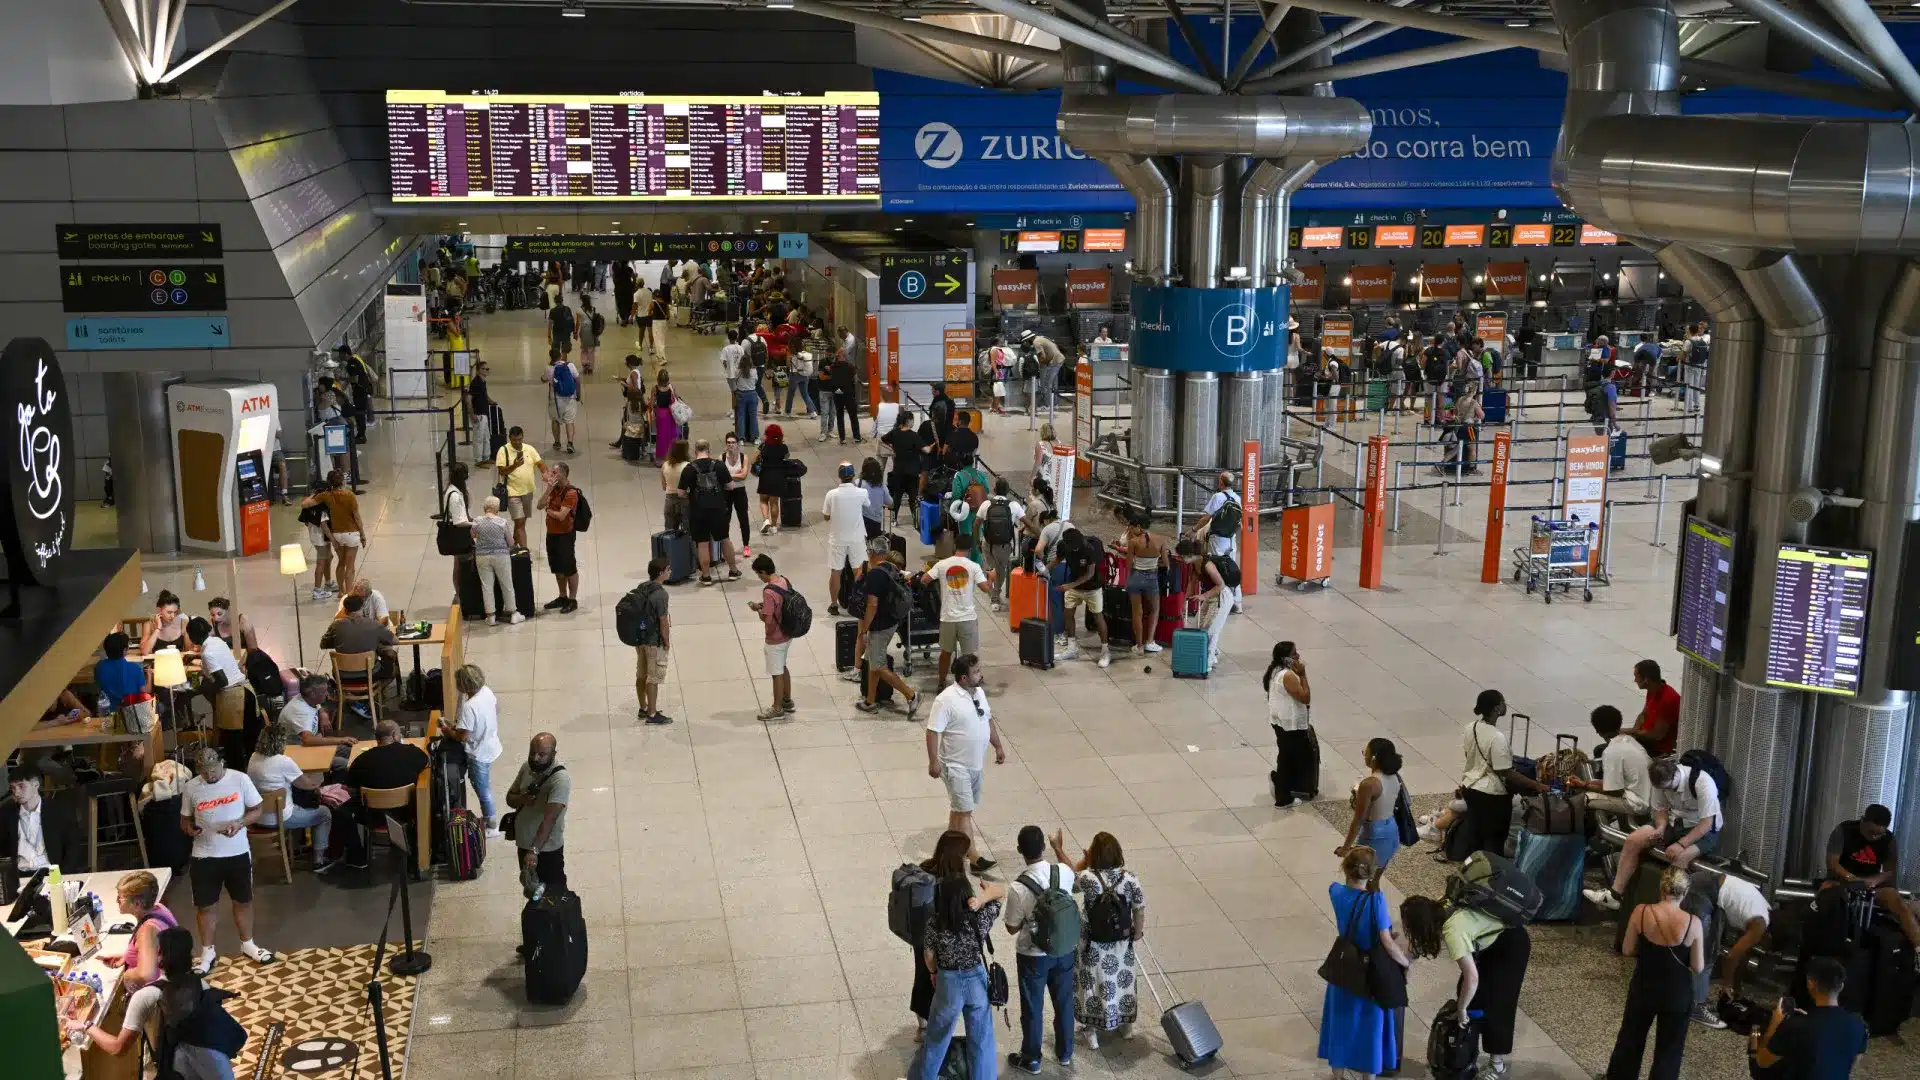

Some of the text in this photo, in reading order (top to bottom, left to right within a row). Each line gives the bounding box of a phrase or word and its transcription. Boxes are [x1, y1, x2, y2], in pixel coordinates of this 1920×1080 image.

[1371, 107, 1440, 128] mos,
[980, 136, 1096, 160] ZURIC
[1341, 134, 1530, 158] do corra bem
[88, 232, 184, 241] portas de embarque
[1290, 232, 1298, 247] 8
[1305, 232, 1340, 241] easyJet
[1350, 232, 1368, 246] 19
[1423, 230, 1442, 245] 20
[1492, 230, 1509, 244] 21
[1555, 229, 1575, 243] 22
[1584, 230, 1614, 239] easyJe
[88, 242, 129, 251] boarding
[131, 242, 156, 251] gates
[91, 272, 119, 282] check
[122, 272, 131, 282] in
[1356, 278, 1387, 286] easyJet
[1425, 276, 1458, 285] easyJet
[907, 276, 918, 293] B
[997, 282, 1032, 291] easyJet
[1072, 282, 1105, 290] easyJet
[1140, 321, 1170, 332] check in
[1227, 315, 1248, 346] B
[241, 395, 270, 412] ATM
[1497, 442, 1506, 459] DROP
[1570, 445, 1605, 454] easyJet
[1496, 460, 1504, 474] BAG
[1569, 462, 1604, 471] BEM-VINDO
[1315, 524, 1324, 572] easyJet
